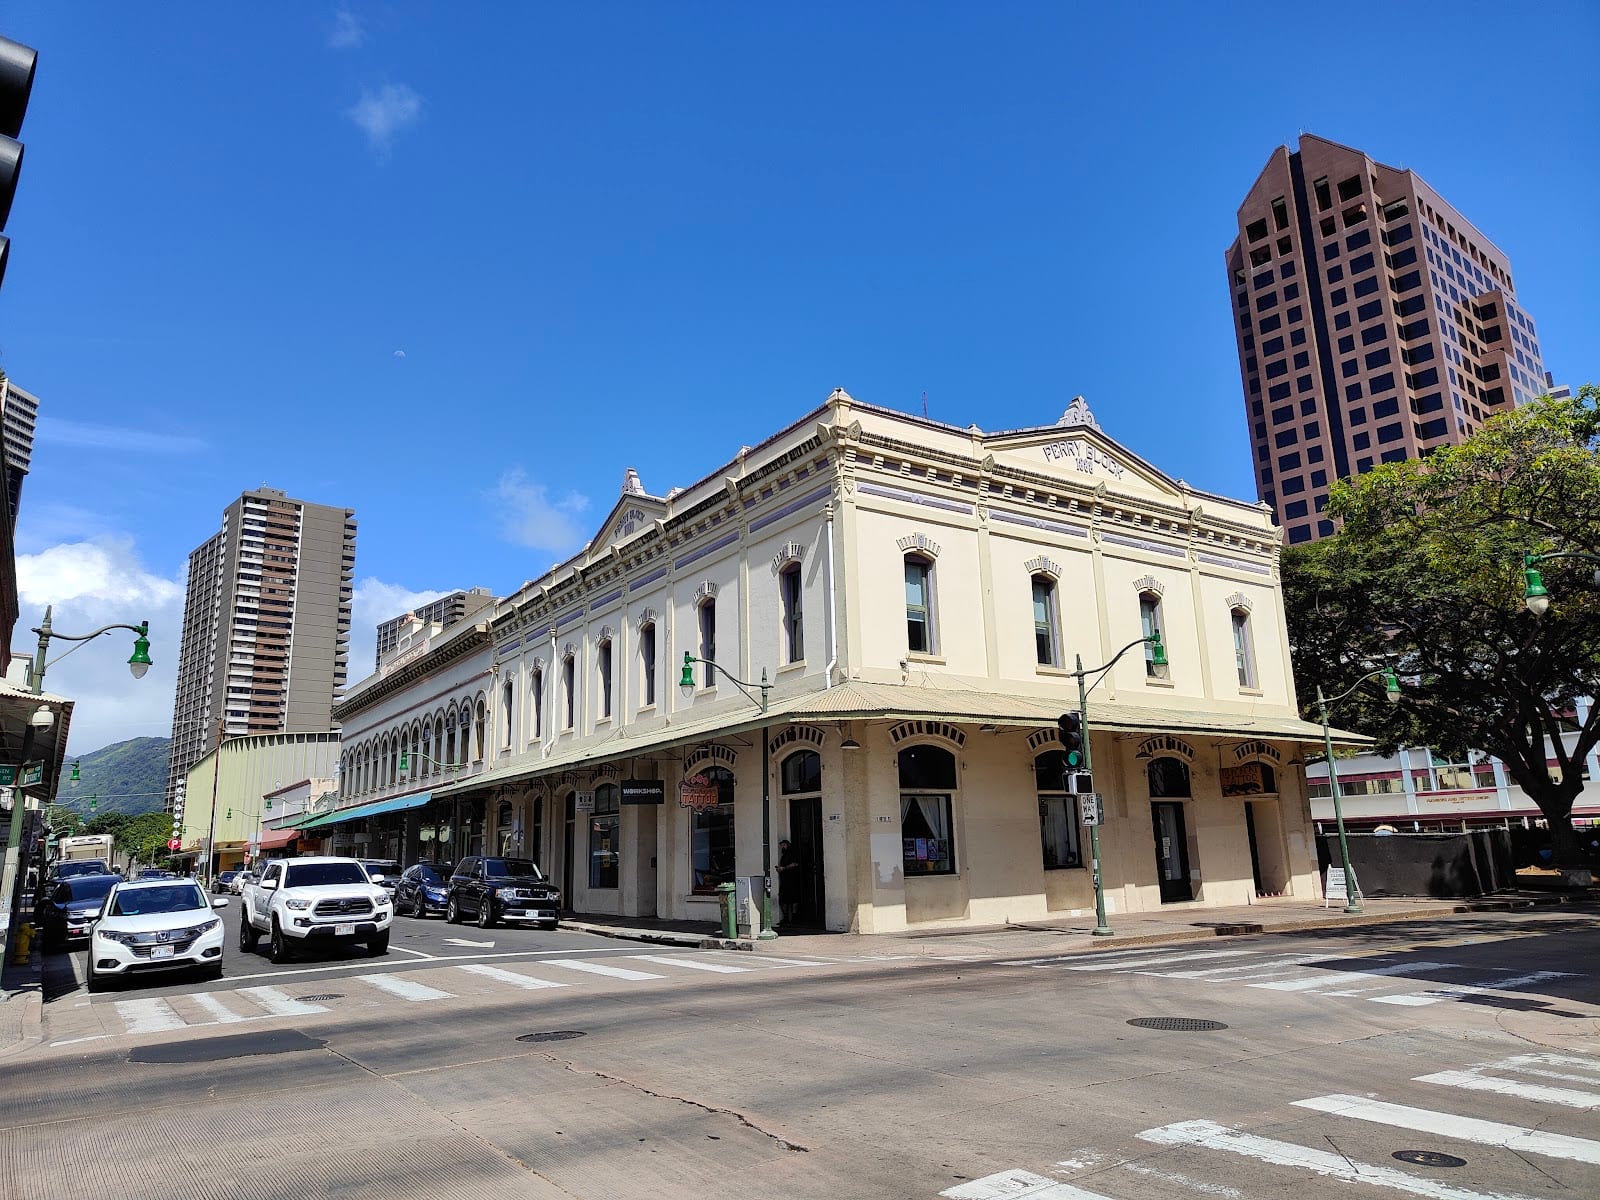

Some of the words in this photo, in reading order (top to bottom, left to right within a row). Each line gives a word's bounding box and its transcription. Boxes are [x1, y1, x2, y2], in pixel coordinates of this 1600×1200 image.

[1042, 440, 1082, 463] PERRY
[1085, 443, 1124, 480] BLOCK
[682, 793, 717, 805] TATTOO
[1082, 796, 1095, 805] ONE
[1082, 804, 1095, 814] WAY
